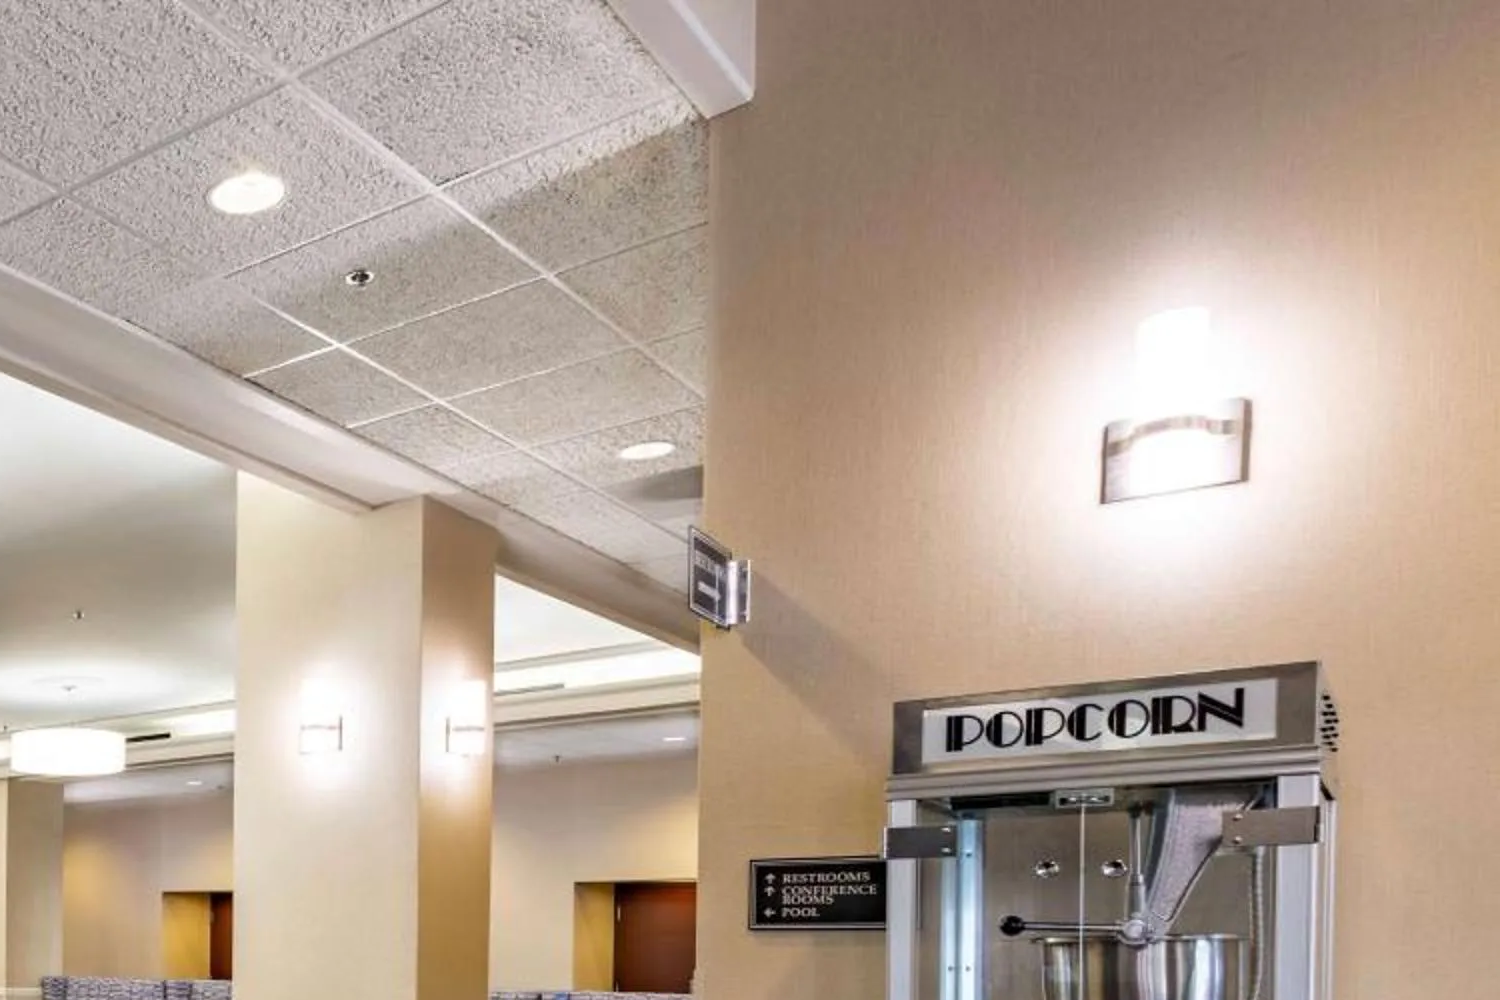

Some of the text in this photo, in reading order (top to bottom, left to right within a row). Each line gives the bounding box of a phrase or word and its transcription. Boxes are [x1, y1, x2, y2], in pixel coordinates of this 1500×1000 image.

[945, 688, 1246, 753] POPCORN
[782, 872, 871, 884] RESTROOMS
[781, 884, 877, 896] CONFERENCE
[781, 895, 834, 905] ROOMS
[781, 907, 821, 918] POOL
